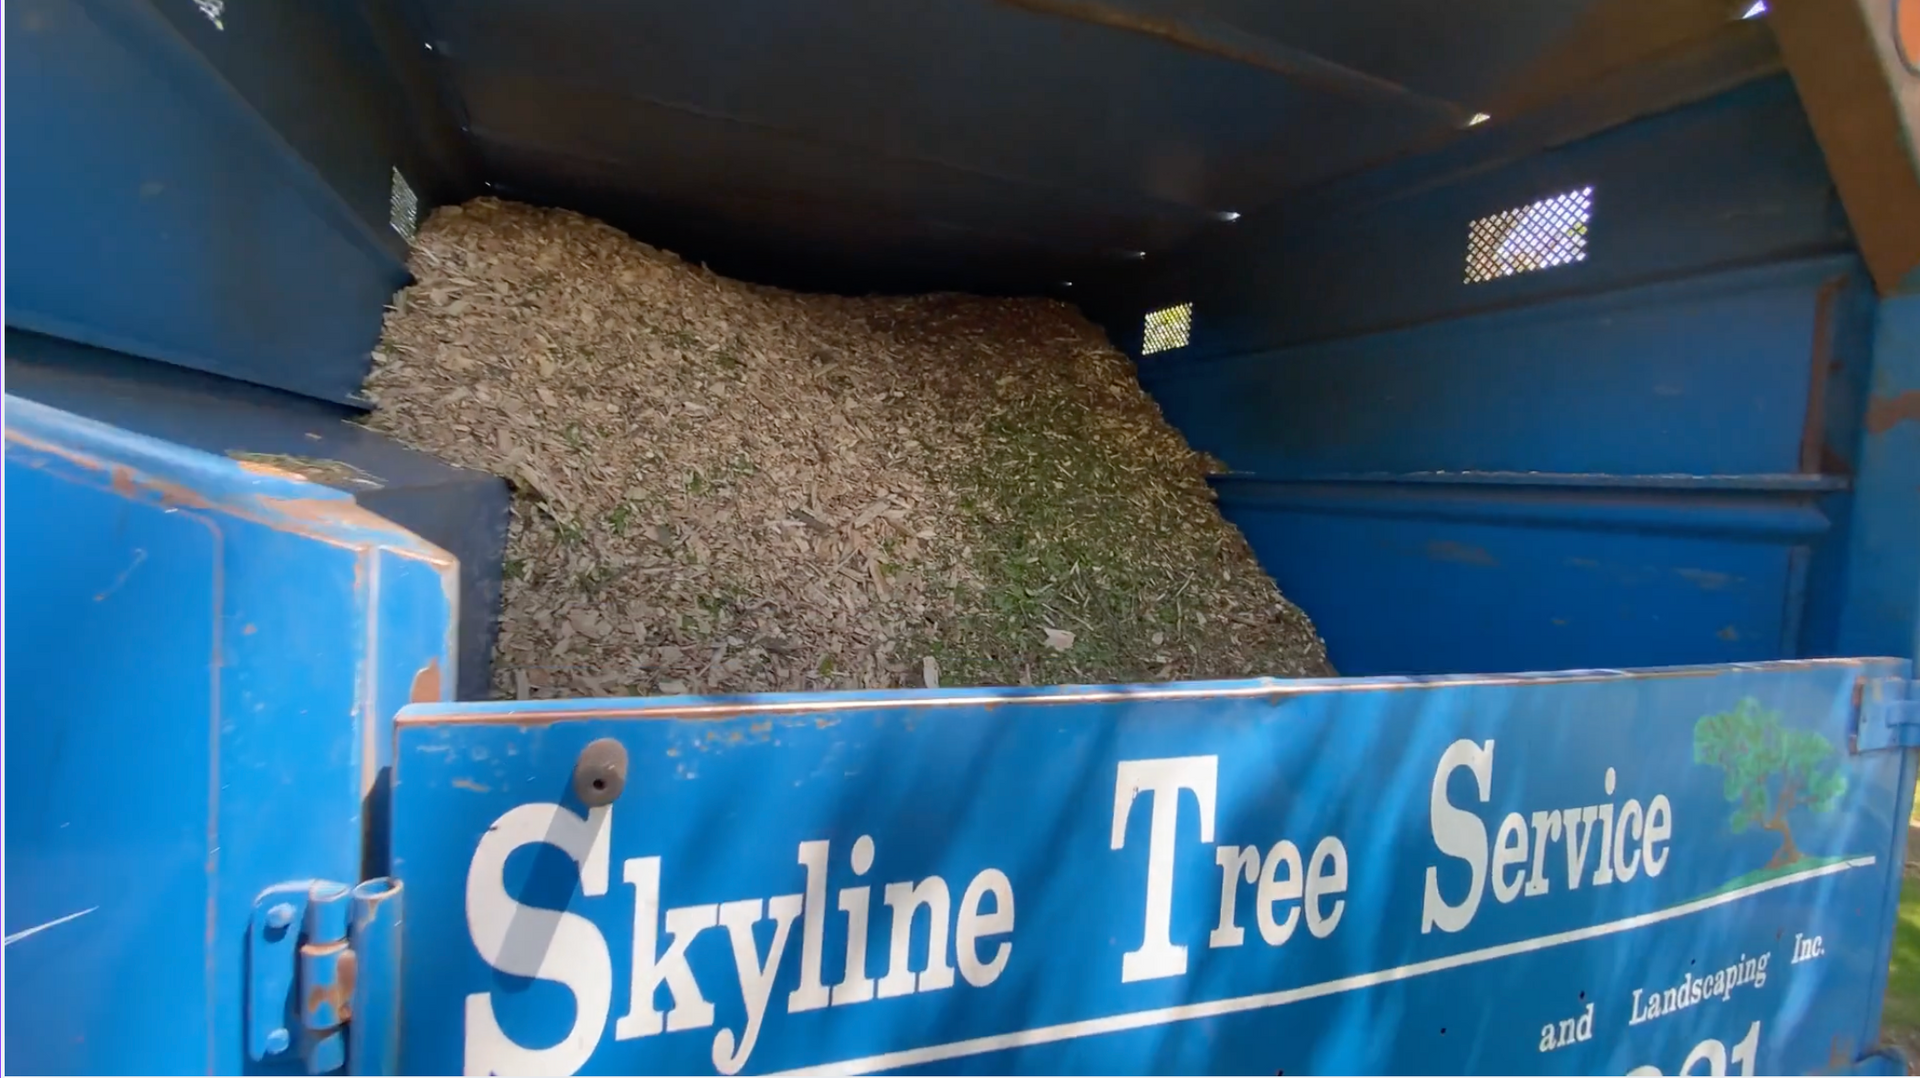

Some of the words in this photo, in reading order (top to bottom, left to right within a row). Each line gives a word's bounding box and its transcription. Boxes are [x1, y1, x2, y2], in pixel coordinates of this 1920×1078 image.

[464, 802, 1015, 1076] Skyline
[1110, 754, 1348, 984] Tree
[1421, 738, 1672, 935] Service
[1539, 1003, 1594, 1053] and
[1628, 951, 1771, 1026] Landscaping
[1791, 932, 1826, 965] Inc.
